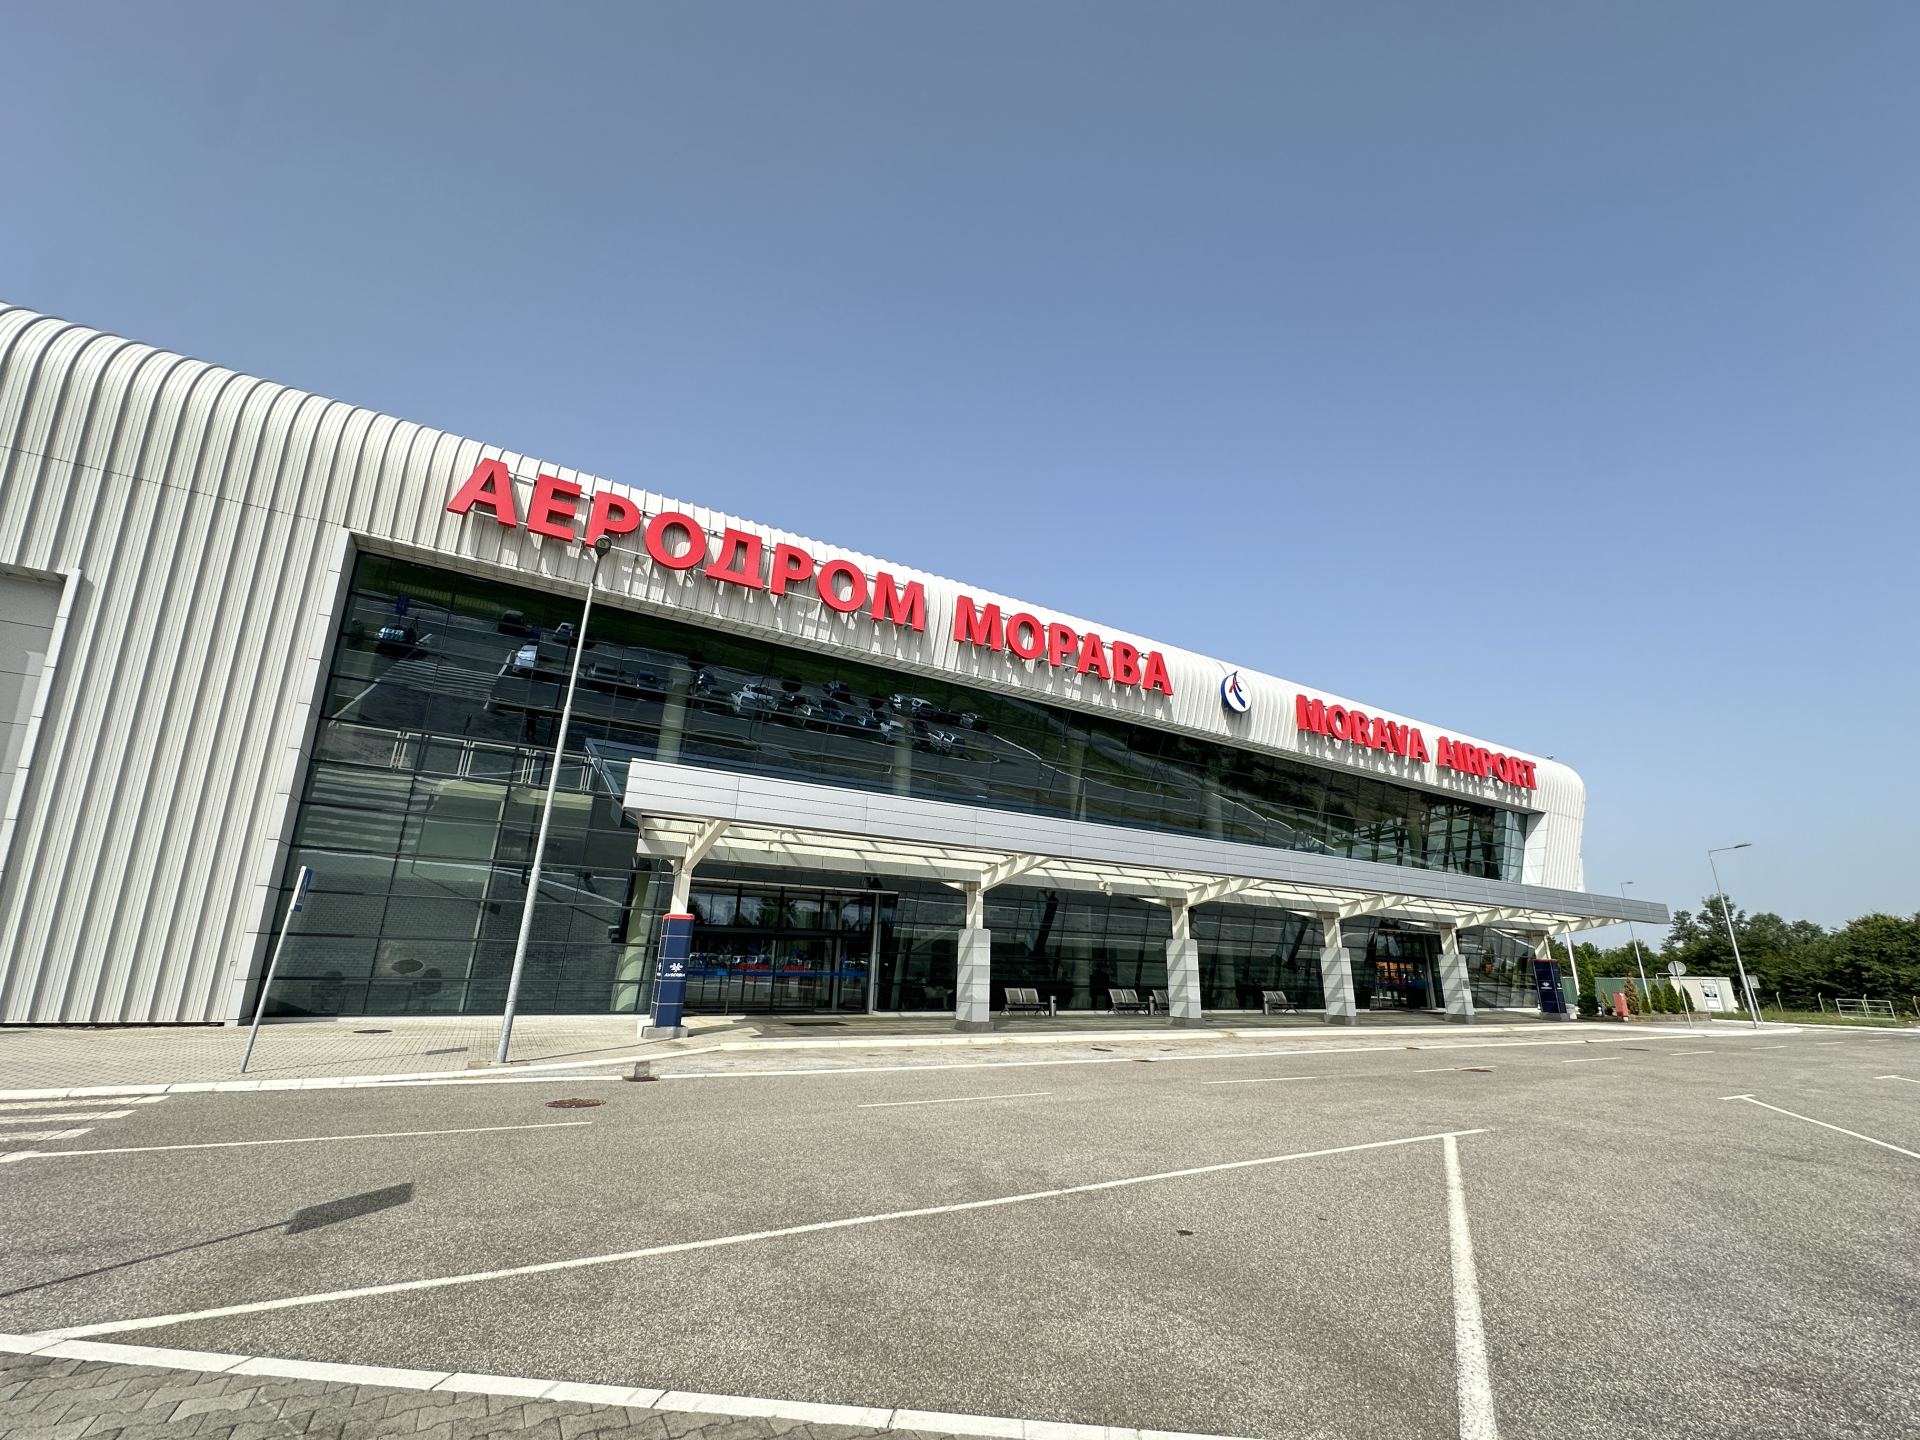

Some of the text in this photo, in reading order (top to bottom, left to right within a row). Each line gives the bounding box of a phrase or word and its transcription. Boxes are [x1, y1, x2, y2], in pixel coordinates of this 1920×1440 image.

[446, 457, 1174, 696] АЕРОДРОМ МОРАВА
[1296, 693, 1538, 791] MORAVA AIRPORT
